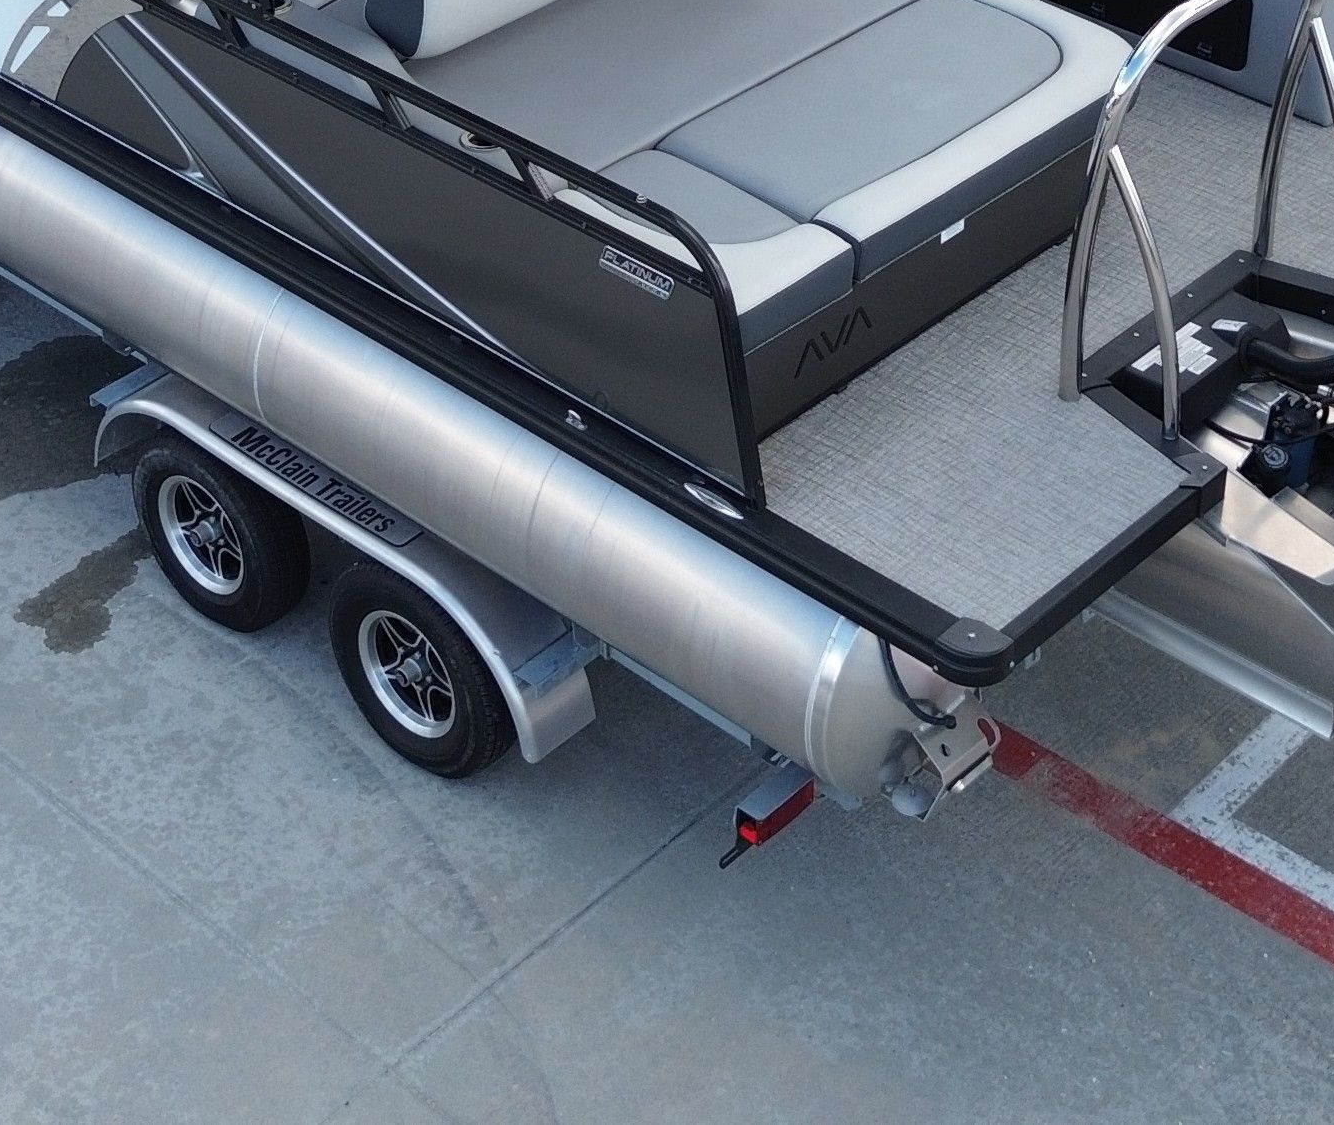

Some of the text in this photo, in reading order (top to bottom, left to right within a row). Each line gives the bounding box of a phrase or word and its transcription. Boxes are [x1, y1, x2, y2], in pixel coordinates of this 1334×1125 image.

[604, 250, 670, 290] PLATINUM
[794, 306, 873, 379] AVA
[231, 426, 396, 532] McClain Trailers
